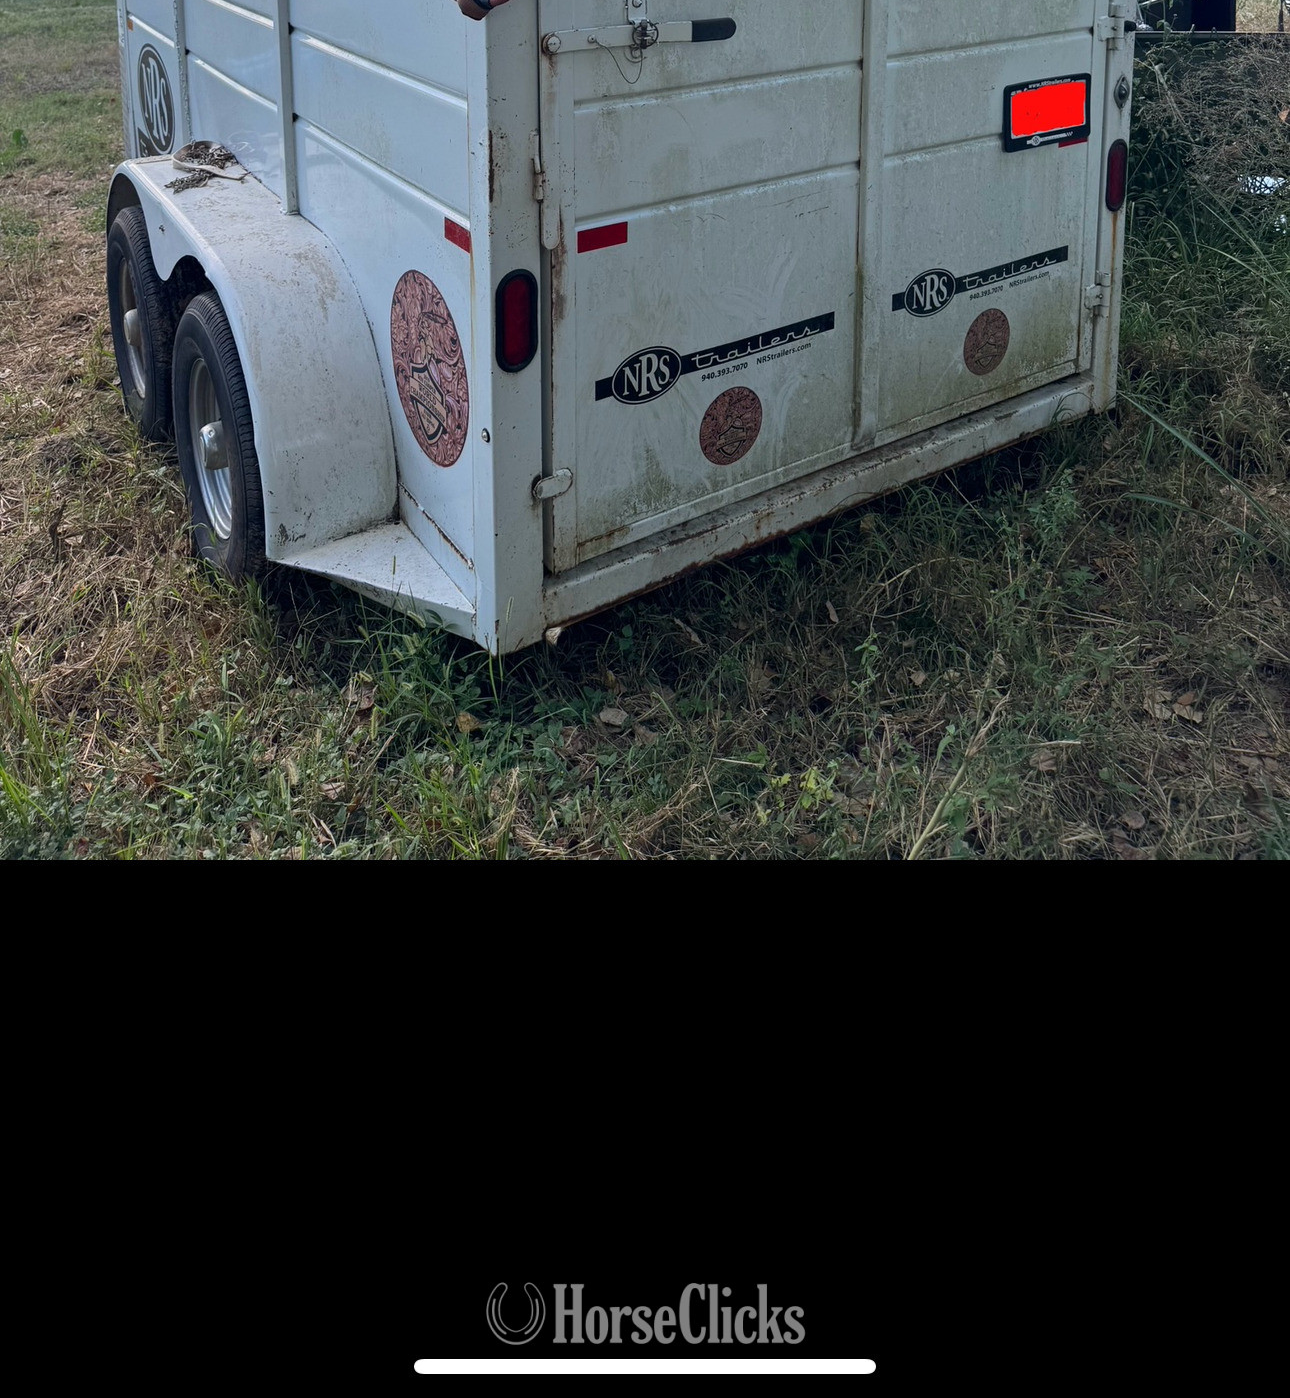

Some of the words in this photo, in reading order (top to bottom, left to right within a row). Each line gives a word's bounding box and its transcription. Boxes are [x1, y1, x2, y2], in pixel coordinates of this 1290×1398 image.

[141, 56, 169, 147] NRS
[912, 274, 949, 311] NRS
[963, 256, 1057, 290] trailers
[969, 285, 1004, 301] 940.393.7070
[1008, 271, 1050, 289] NRStrailers.com
[622, 353, 671, 398] NRS
[691, 326, 820, 370] trailers
[701, 362, 748, 382] 940.393.7070
[756, 343, 812, 366] NRStrailers.com
